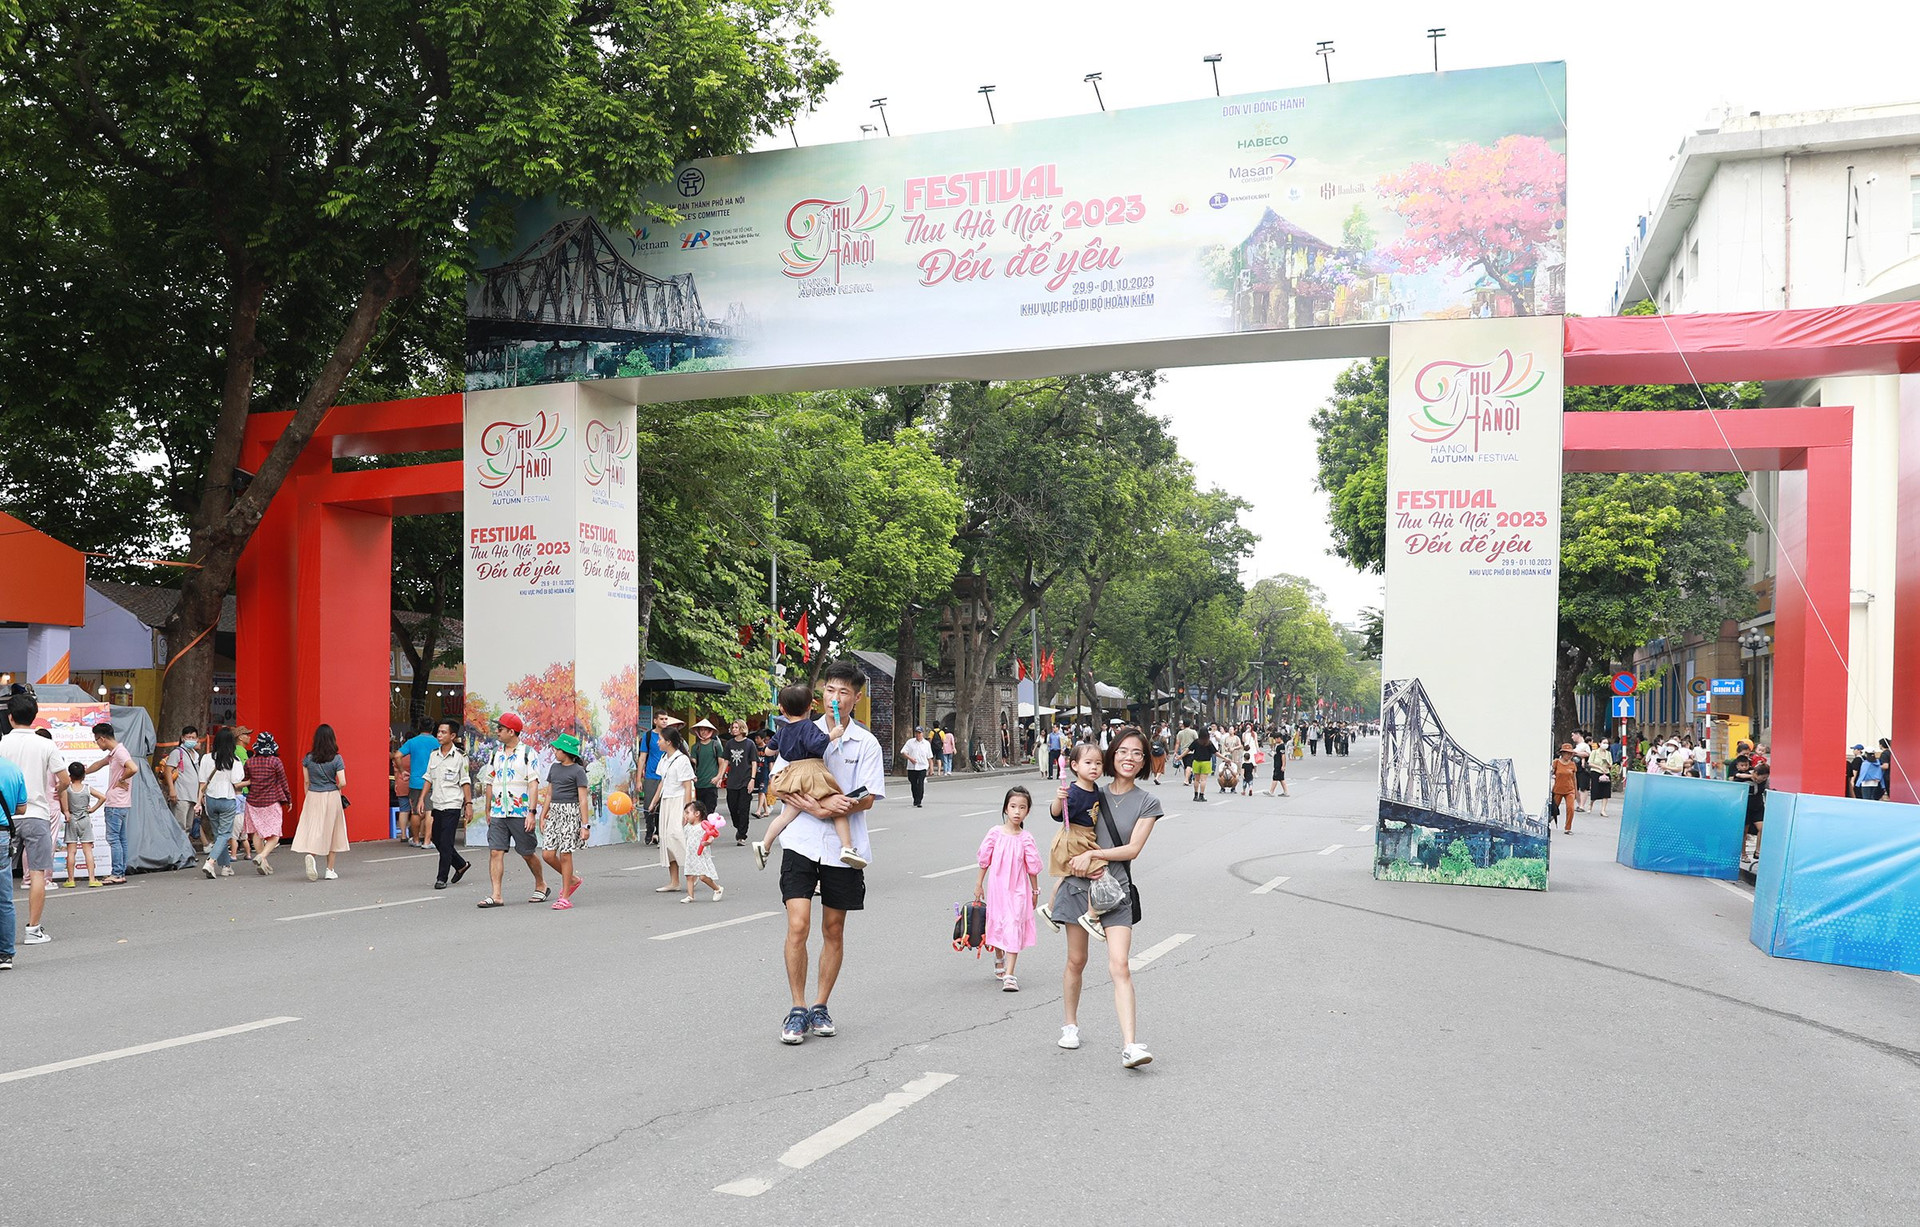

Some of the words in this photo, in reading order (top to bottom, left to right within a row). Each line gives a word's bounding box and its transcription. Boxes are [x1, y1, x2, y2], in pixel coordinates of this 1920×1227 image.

[1237, 135, 1288, 149] HABECO
[1229, 165, 1273, 179] Masan
[1241, 175, 1273, 184] consumer
[904, 164, 1064, 211] FESTIVAL
[698, 208, 731, 219] COMMITTEE
[901, 213, 947, 245] Thu
[953, 208, 996, 240] Hà
[1002, 203, 1053, 242] Nội
[1063, 194, 1147, 230] 2023
[627, 237, 669, 257] Vietnam
[917, 241, 995, 287] Đến
[1004, 231, 1063, 278] để
[1045, 236, 1124, 292] yêu
[798, 286, 837, 299] AUTUMN
[1101, 275, 1155, 293] 01.10.2023
[1020, 301, 1040, 316] KHU
[1430, 444, 1468, 454] HANOI
[1430, 454, 1474, 464] AUTUMN
[1478, 453, 1520, 463] FESTIVAL
[492, 496, 522, 506] AUTUMN
[523, 494, 551, 505] FESTIVAL
[1397, 489, 1497, 510] FESTIVAL
[1395, 512, 1423, 530] Thu
[1428, 511, 1455, 530] Hà
[1459, 511, 1490, 533] Nội
[1496, 511, 1548, 528] 2023
[470, 524, 537, 544] FESTIVAL
[579, 522, 618, 545] FESTIVAL
[469, 545, 489, 560] Thu
[491, 544, 509, 559] Hà
[511, 542, 533, 560] Nội
[536, 541, 571, 556] 2023
[1404, 531, 1454, 555] Đến
[1459, 528, 1497, 553] để
[1485, 533, 1534, 563] yêu
[616, 547, 636, 563] 2023
[476, 560, 508, 580] Đến
[512, 556, 537, 577] để
[529, 559, 561, 585] yêu
[582, 558, 602, 577] Đến
[1469, 568, 1481, 576] KHU
